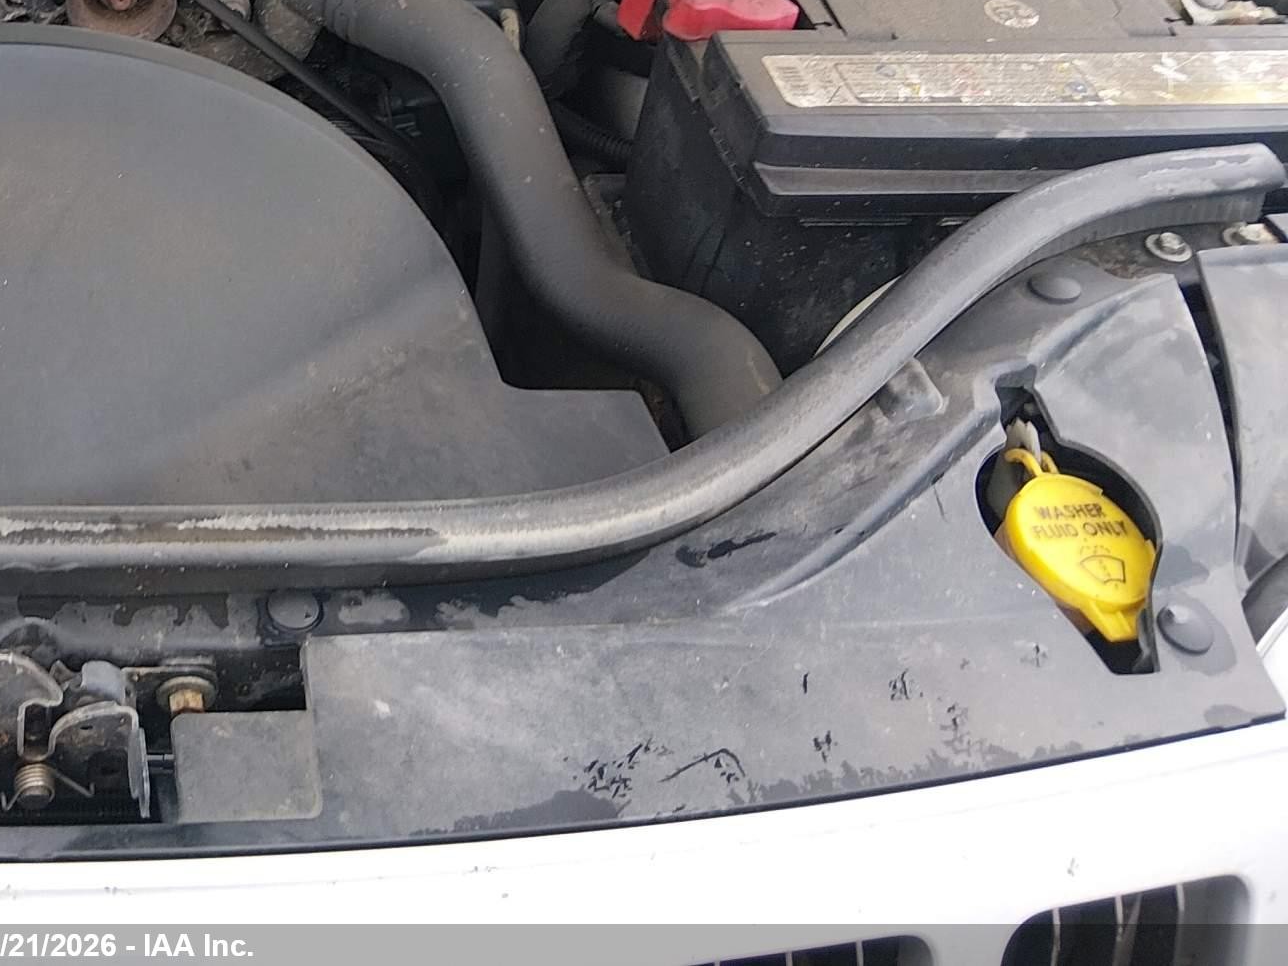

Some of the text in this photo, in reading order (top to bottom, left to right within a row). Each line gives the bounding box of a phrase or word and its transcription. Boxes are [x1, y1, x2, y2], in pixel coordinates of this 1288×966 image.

[1037, 504, 1103, 519] WASHER
[1035, 521, 1127, 538] FLUID ONLY
